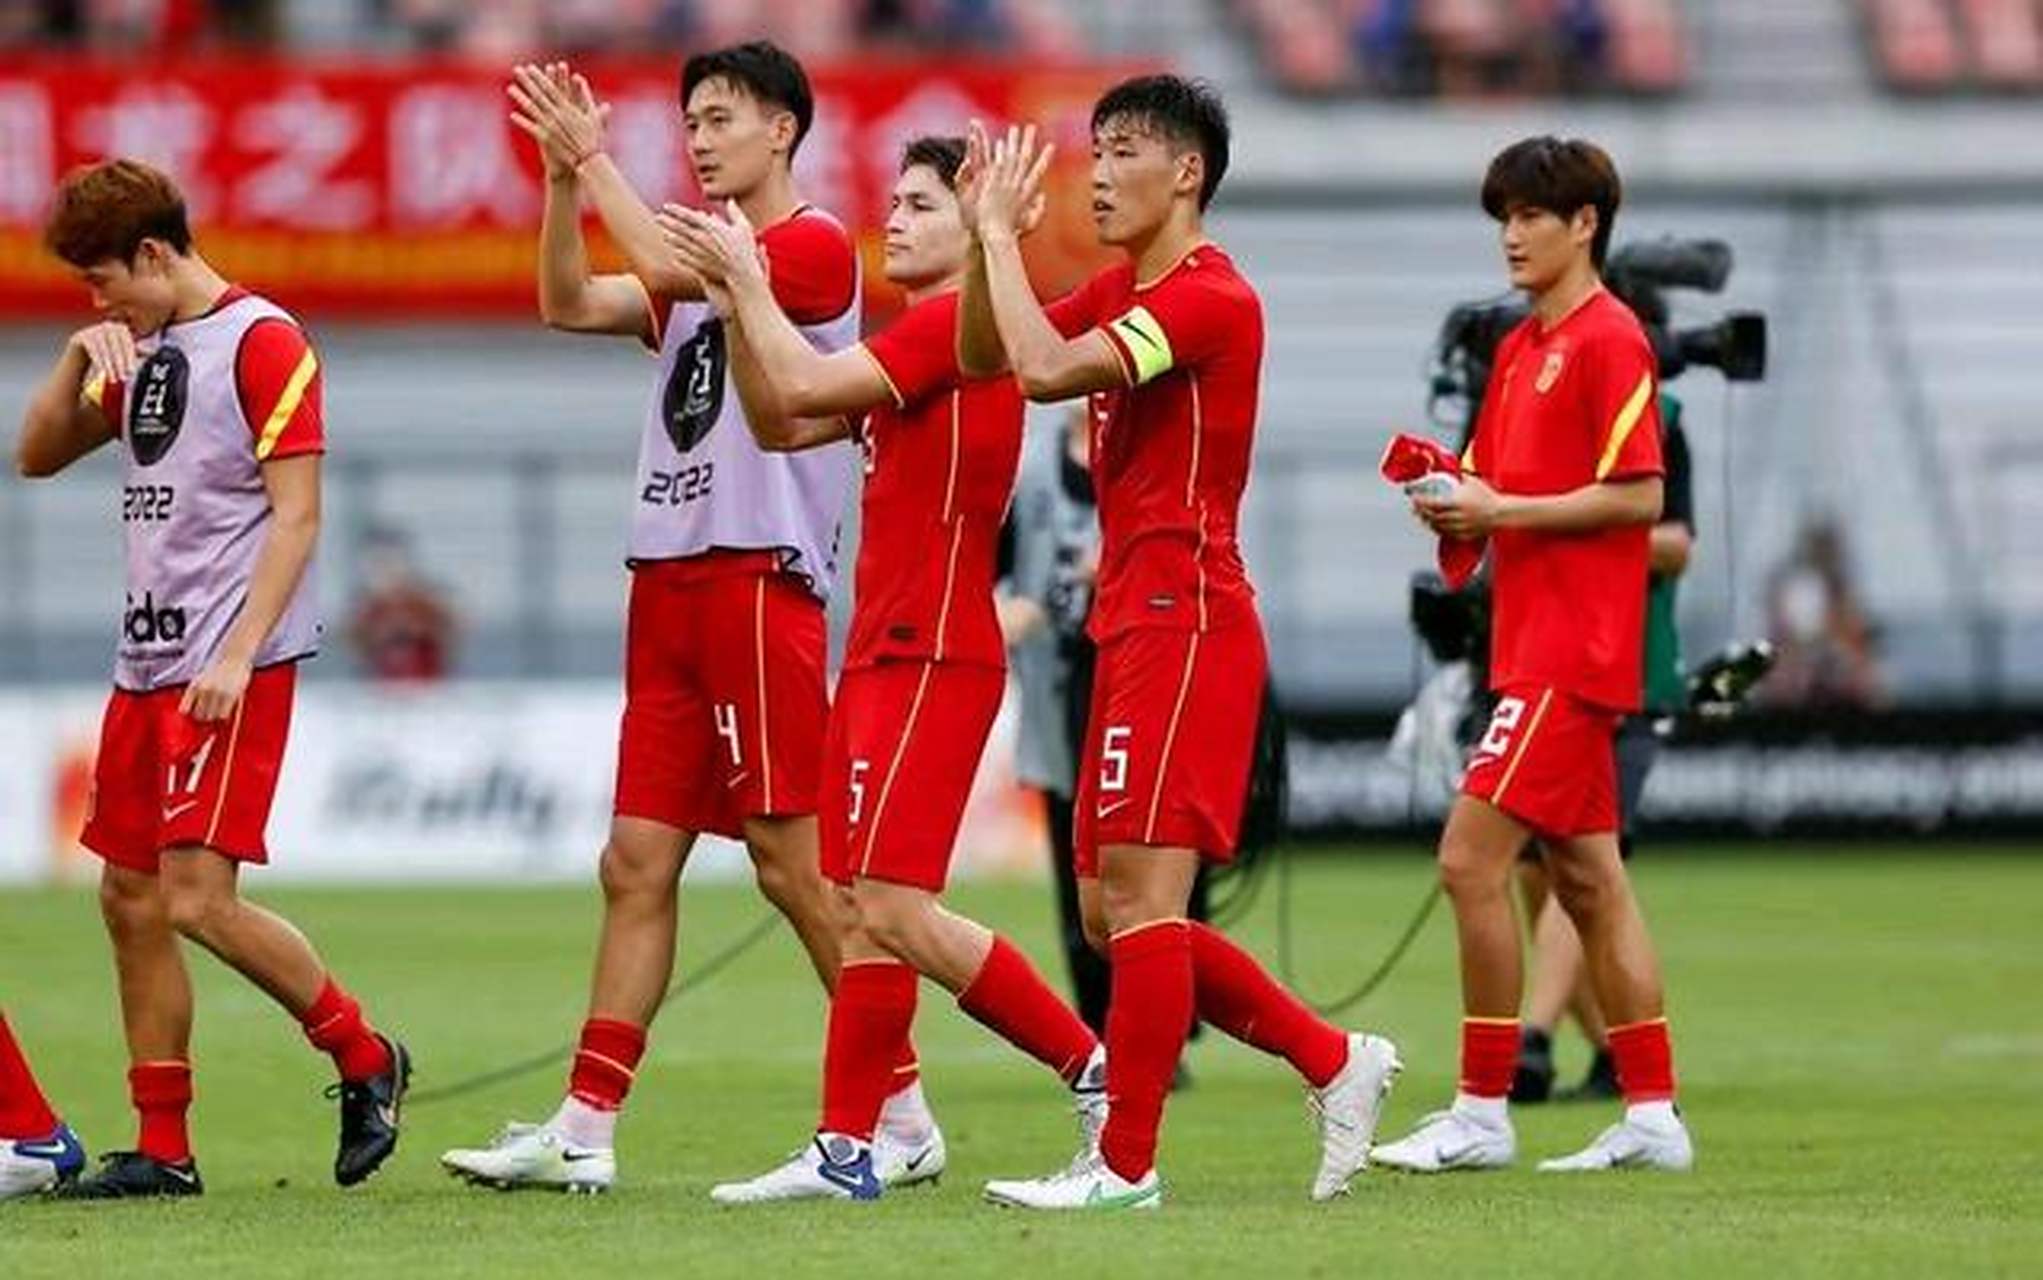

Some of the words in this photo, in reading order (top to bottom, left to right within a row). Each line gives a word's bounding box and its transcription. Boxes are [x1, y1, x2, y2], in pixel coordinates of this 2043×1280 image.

[123, 484, 174, 522] 2022
[642, 462, 715, 506] 2022
[713, 703, 742, 766] 4
[1100, 726, 1132, 790] 5
